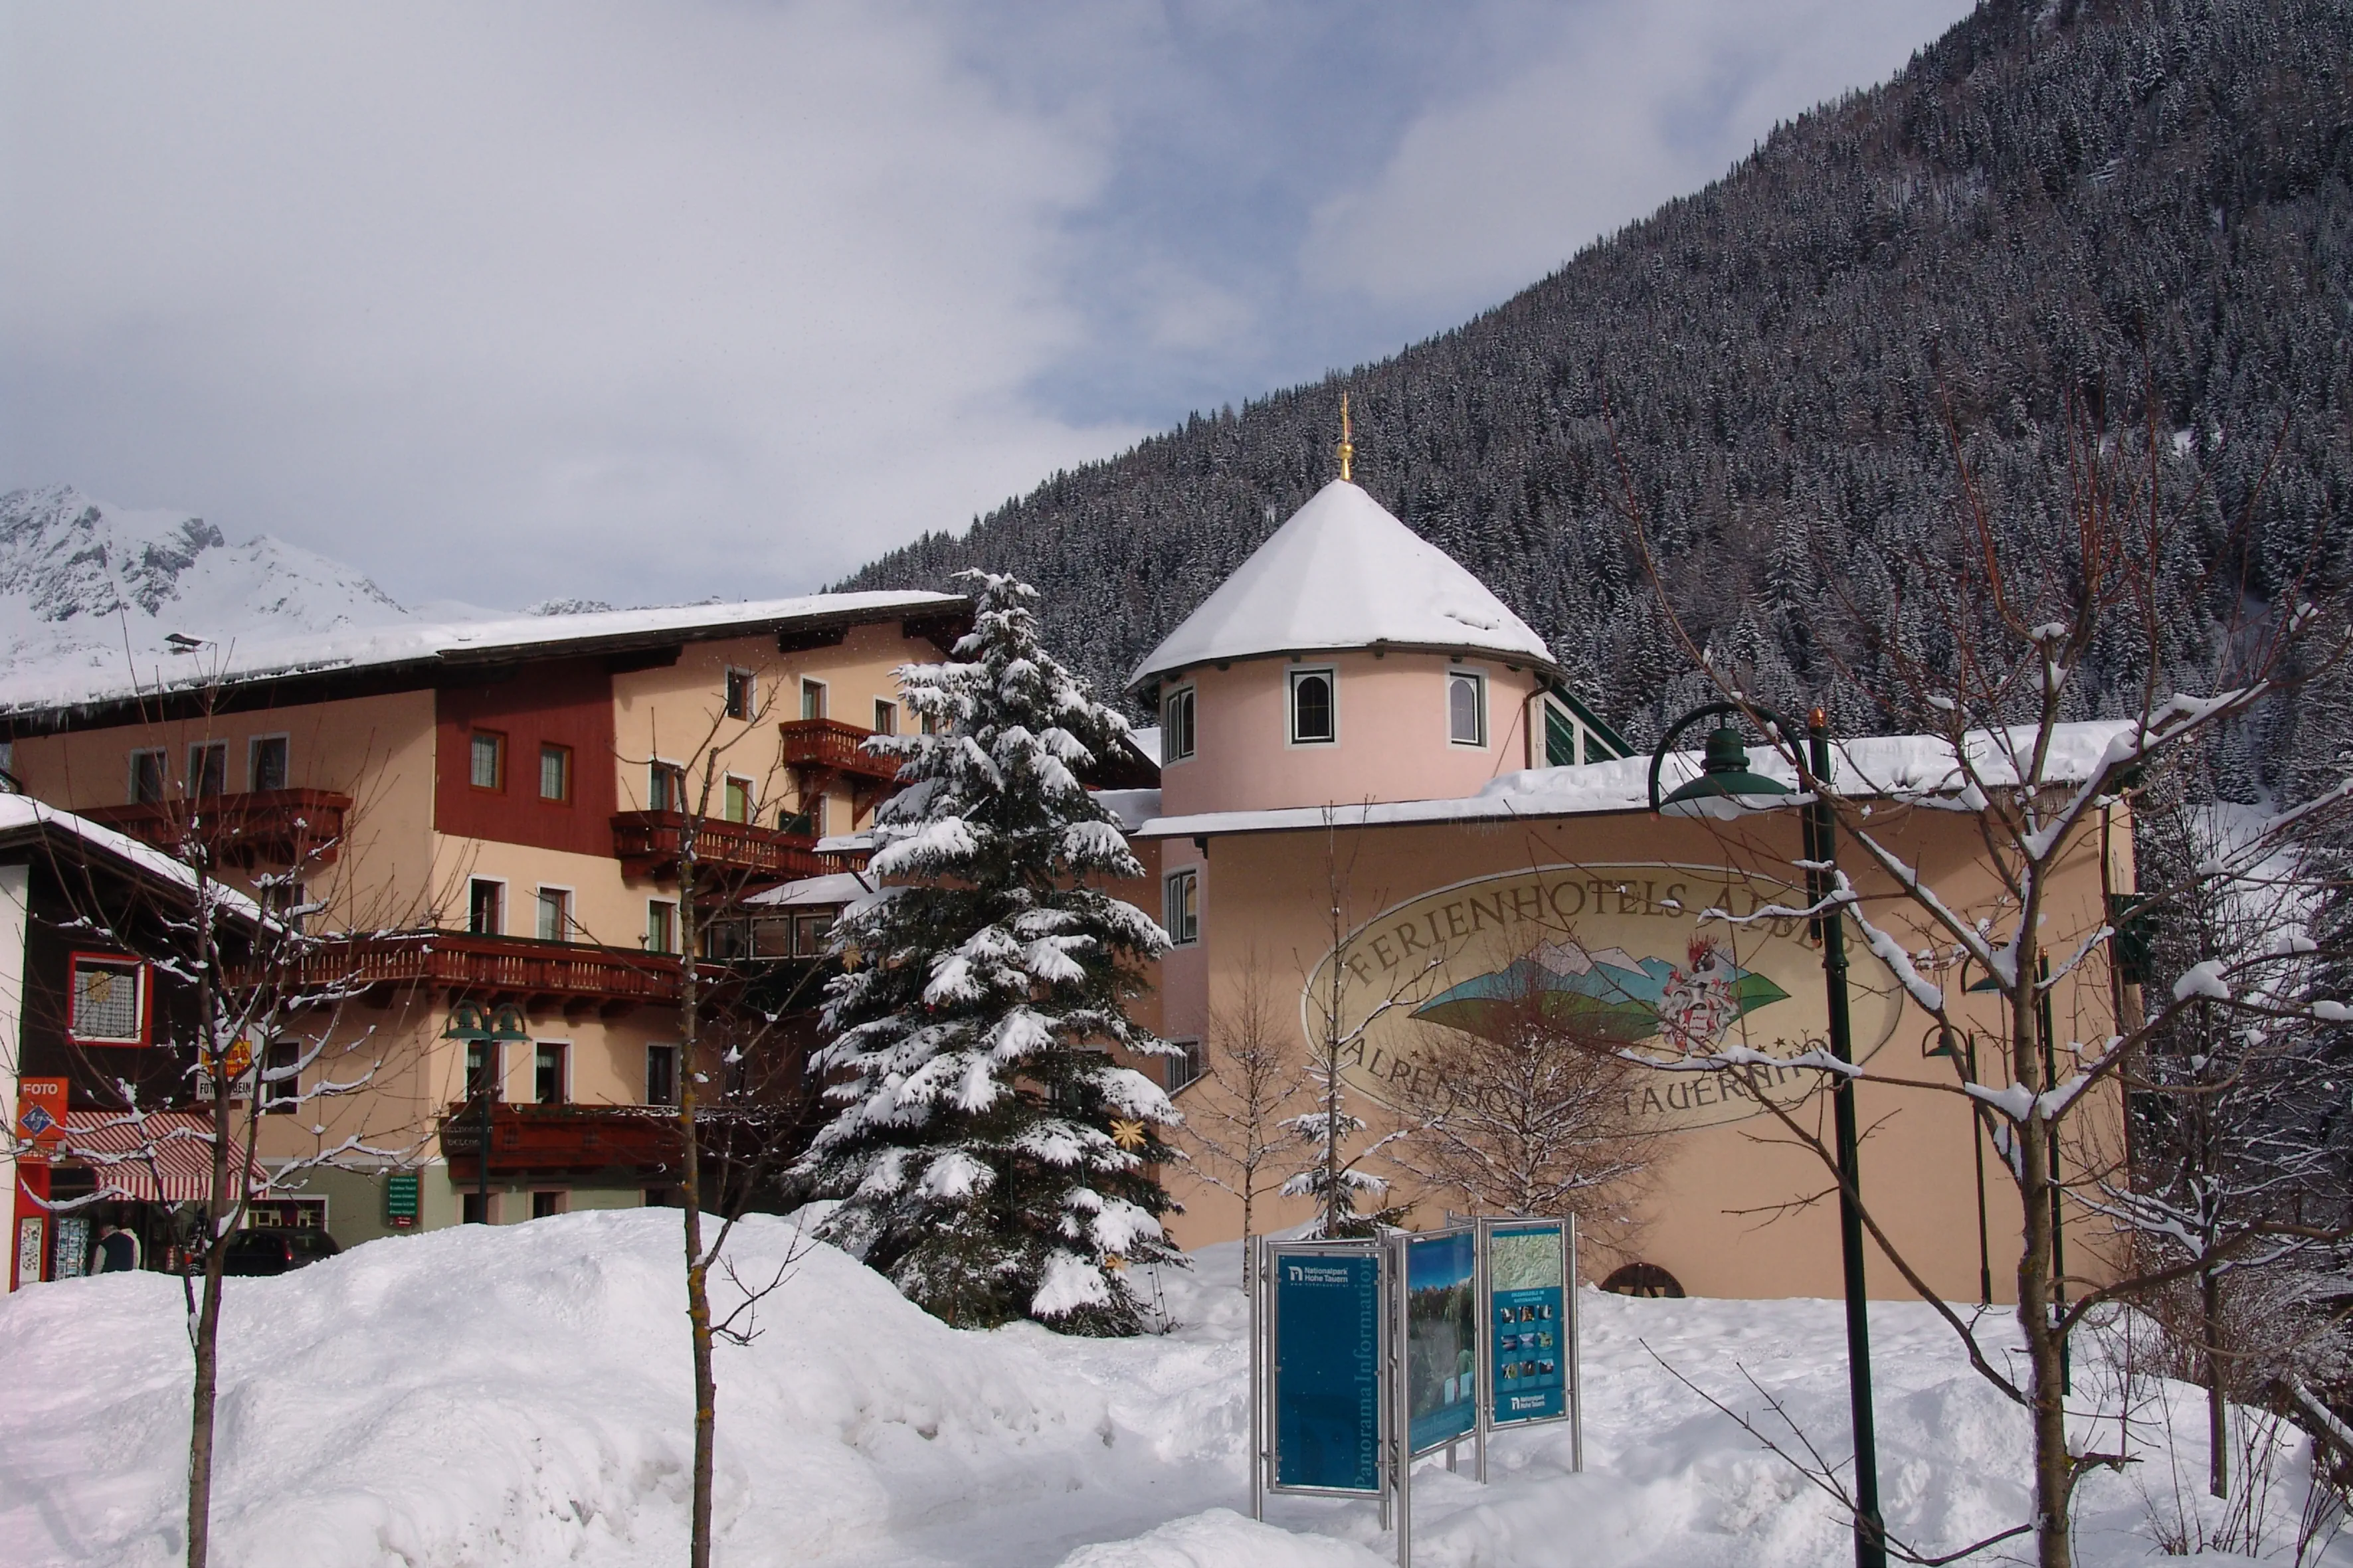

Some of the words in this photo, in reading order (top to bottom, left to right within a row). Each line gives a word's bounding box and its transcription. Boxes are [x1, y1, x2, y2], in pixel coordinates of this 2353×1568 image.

[1345, 879, 1687, 988] FERIENHOTELS
[23, 1083, 58, 1095] FOTO
[1304, 1266, 1349, 1276] Nationalpark
[1304, 1274, 1324, 1283] Hohe
[1325, 1274, 1349, 1283] Tauern
[1353, 1257, 1372, 1383] Information
[1354, 1386, 1372, 1488] Panorama
